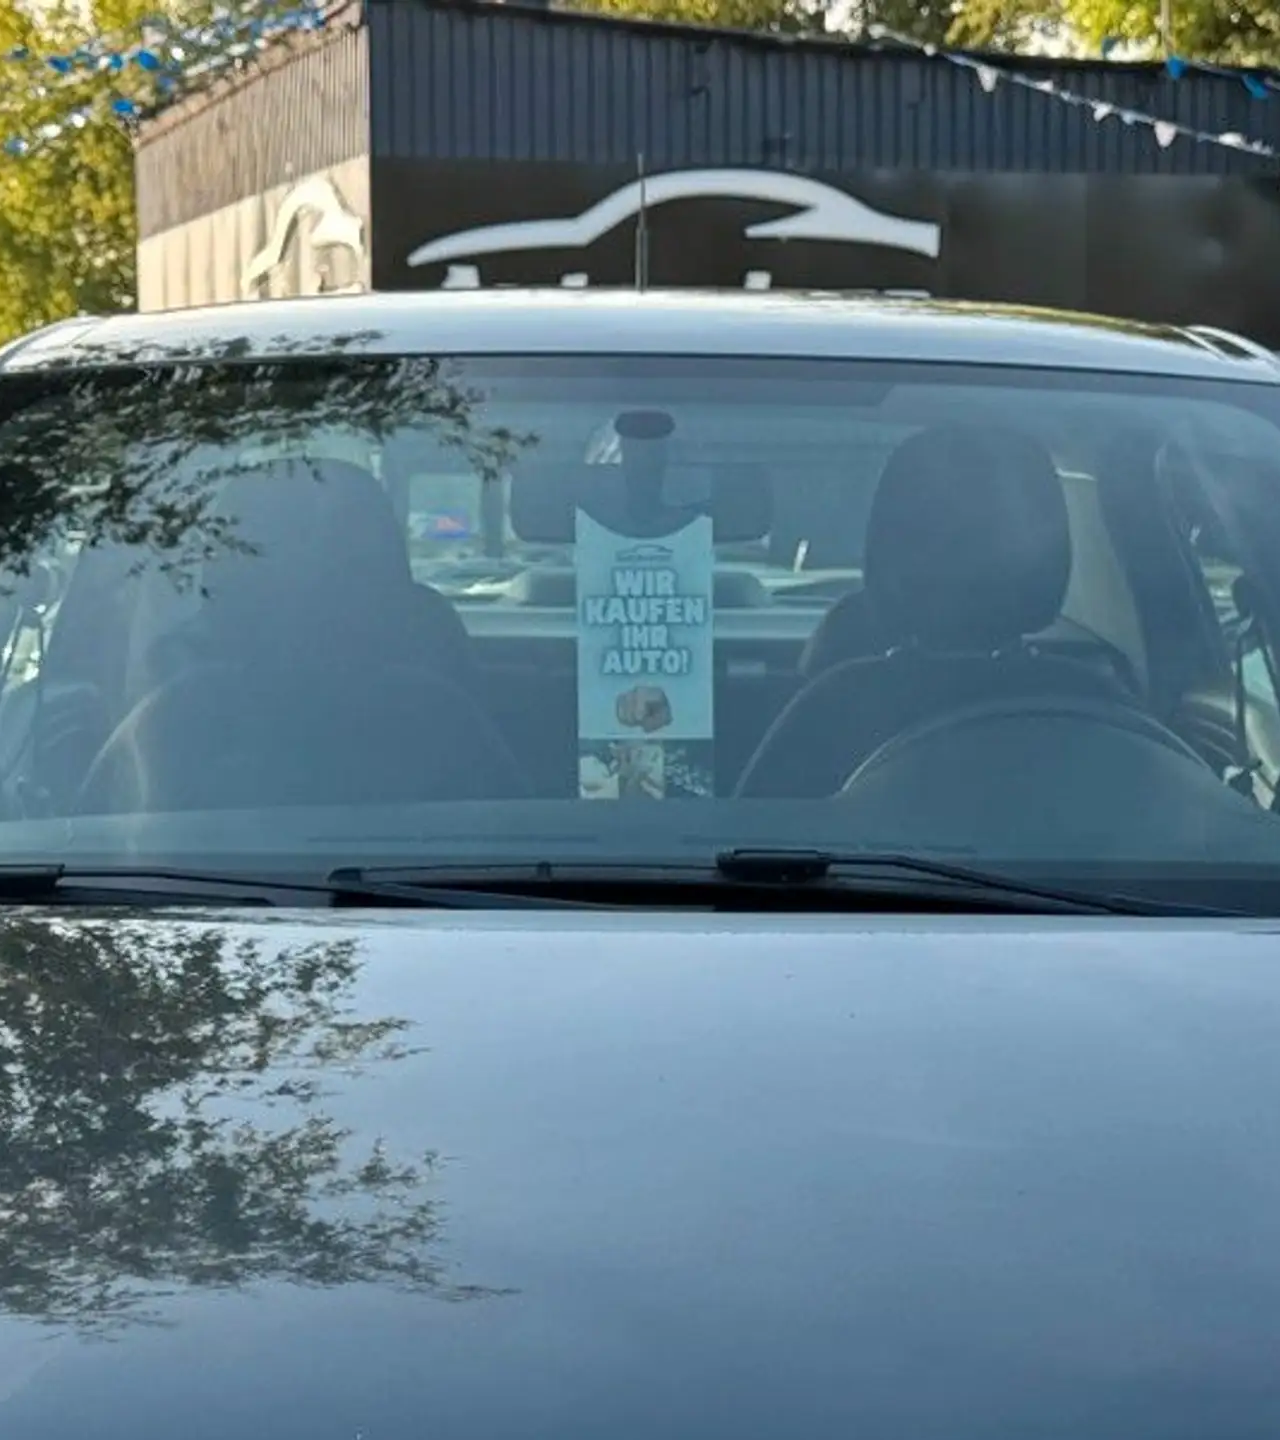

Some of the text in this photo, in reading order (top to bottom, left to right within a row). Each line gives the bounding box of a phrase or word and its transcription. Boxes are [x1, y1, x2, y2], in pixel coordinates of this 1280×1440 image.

[615, 569, 676, 597] WIR
[584, 597, 706, 624] KAUFEN
[622, 624, 668, 649] IHR
[602, 648, 690, 675] AUTO!
